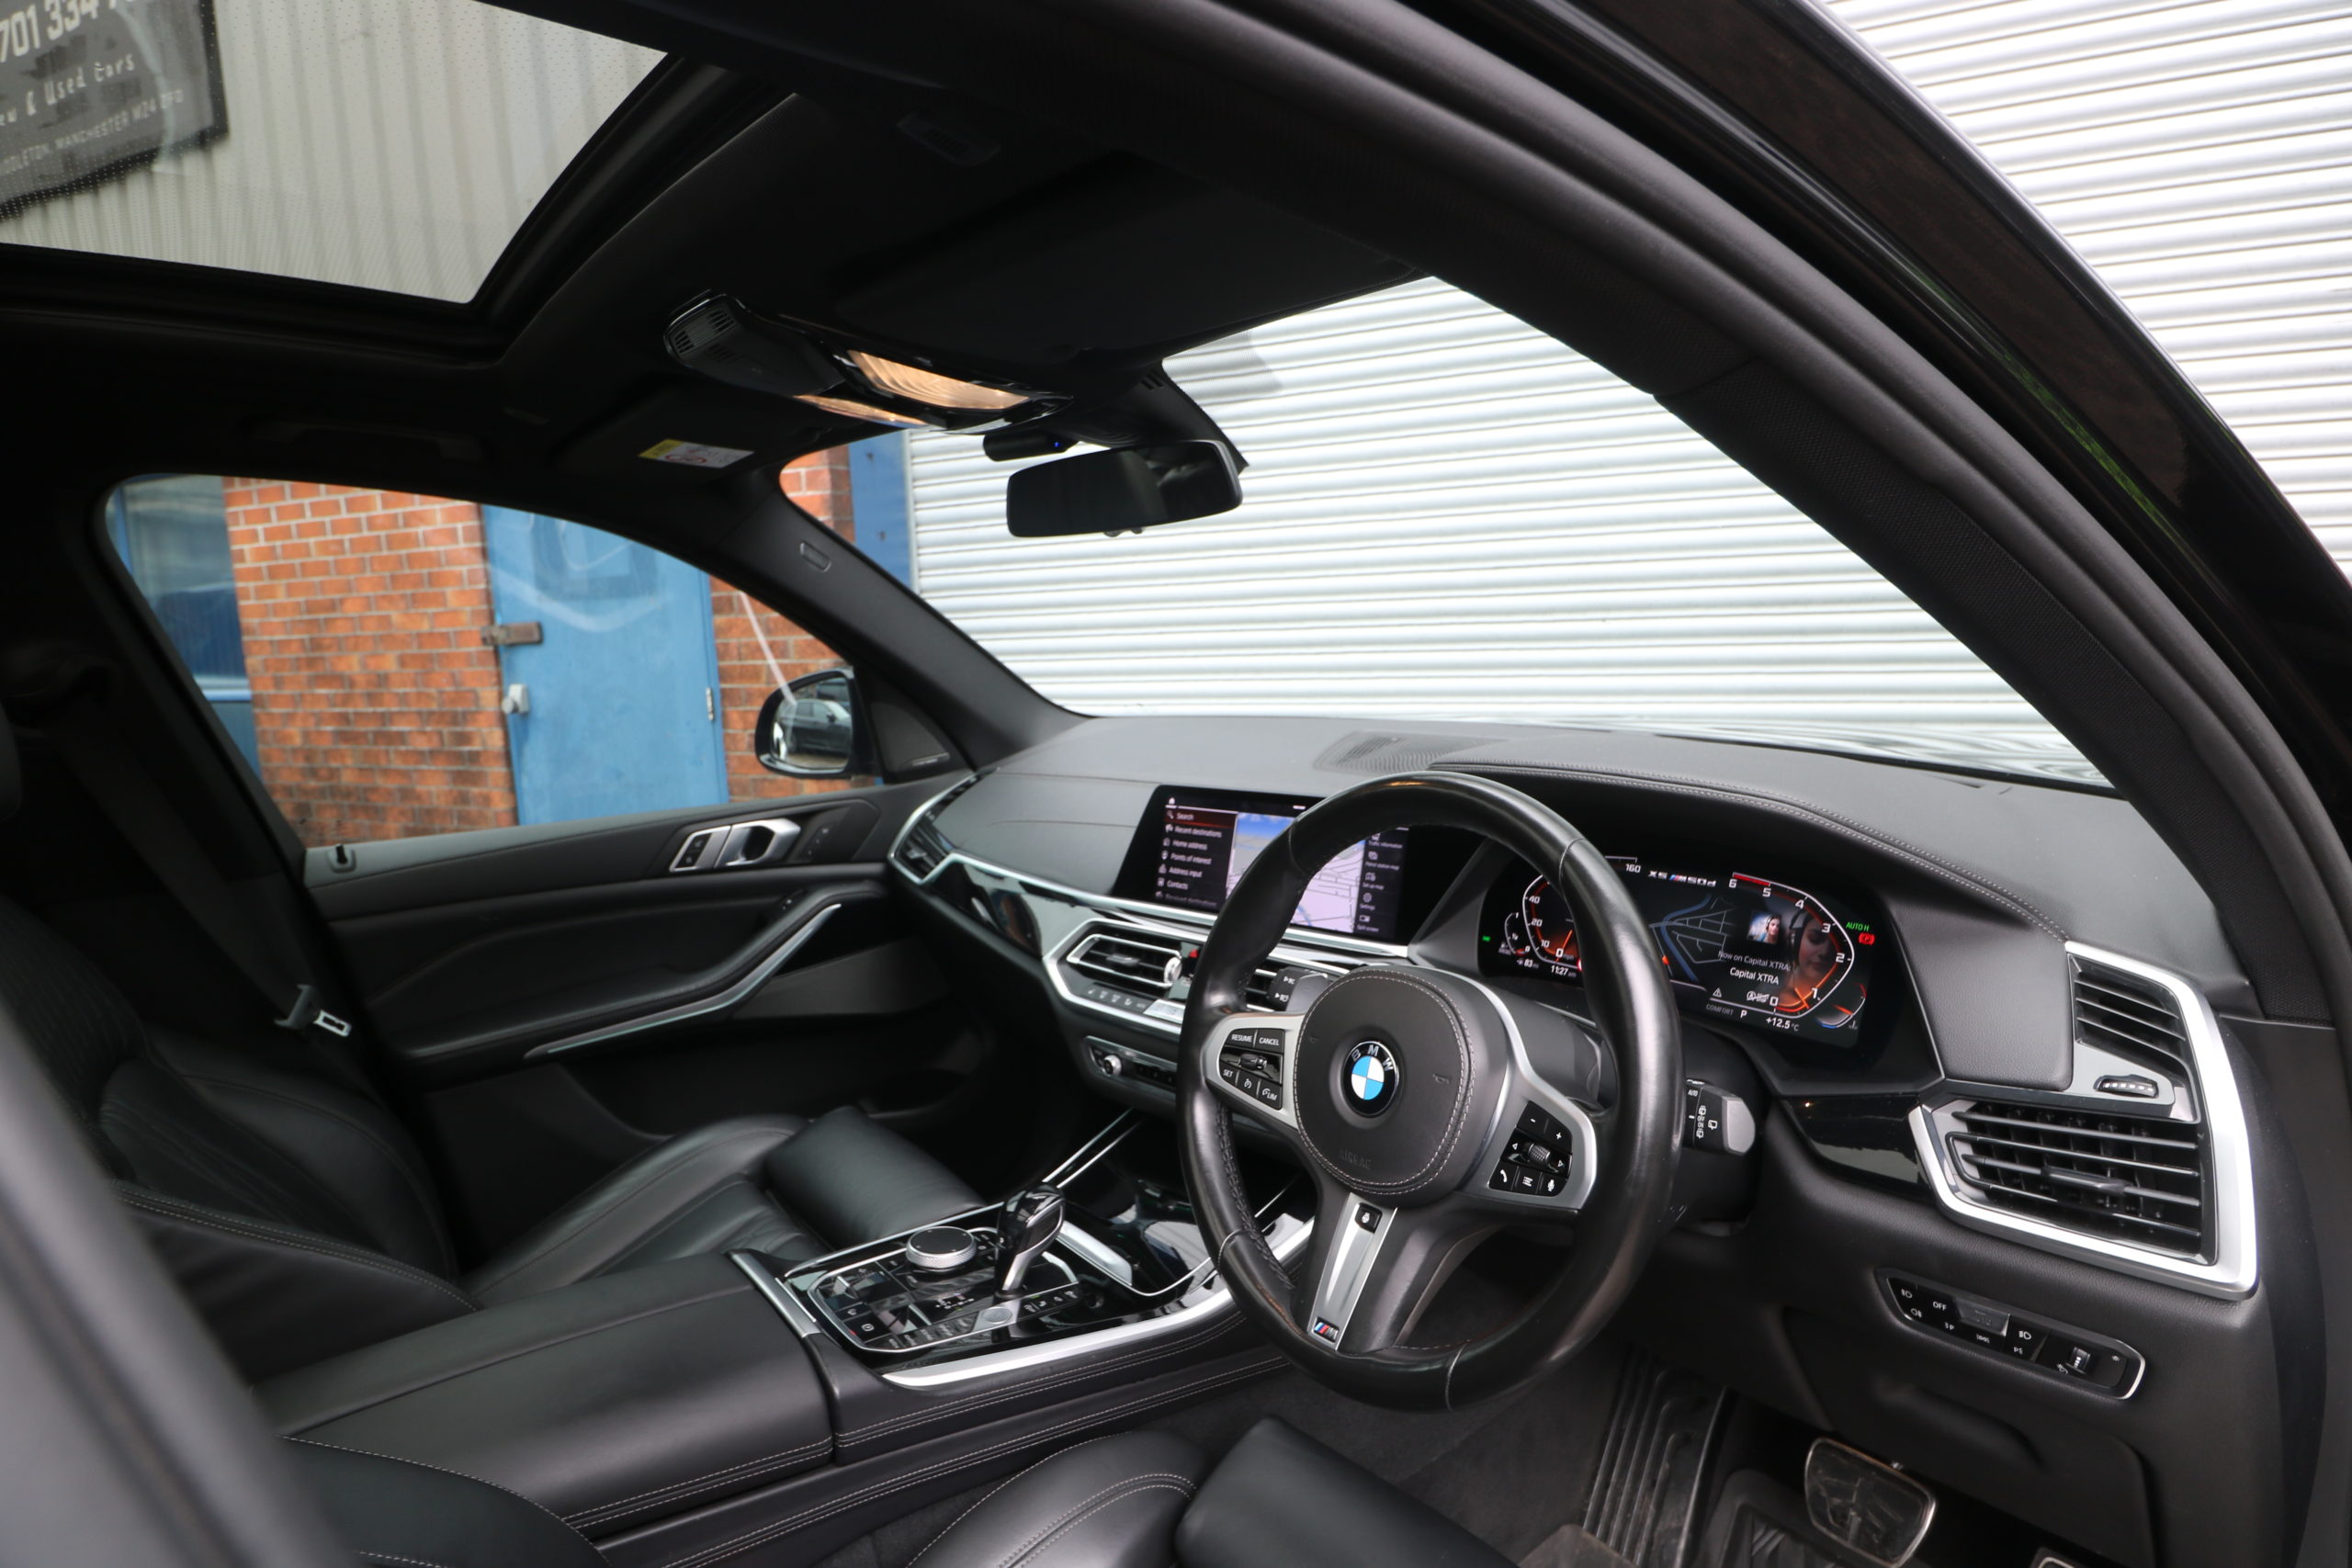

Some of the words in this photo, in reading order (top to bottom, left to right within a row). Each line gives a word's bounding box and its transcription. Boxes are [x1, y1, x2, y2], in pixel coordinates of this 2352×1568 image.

[44, 66, 87, 106] Used
[94, 54, 135, 83] Cars
[55, 109, 130, 150] MANCHESTER
[1177, 812, 1193, 820] Search
[1175, 826, 1192, 834] Recent
[1193, 829, 1222, 838] destinations
[1172, 839, 1188, 847] Home
[1625, 863, 1641, 874] 160
[1648, 870, 1668, 880] X5
[1729, 878, 1737, 888] 6
[1762, 887, 1771, 897] 5
[1529, 896, 1541, 904] 40
[1794, 899, 1804, 909] 4
[1531, 919, 1543, 927] 20
[1822, 923, 1831, 933] 3
[1846, 921, 1863, 931] AUTO
[1541, 940, 1550, 948] 10
[1555, 948, 1564, 958] 0
[1836, 953, 1845, 963] 2
[1524, 959, 1533, 967] 83
[1718, 951, 1732, 960] Now
[1744, 956, 1768, 967] Capital
[1551, 964, 1569, 976] 11:27
[1729, 967, 1757, 980] Capital
[1758, 973, 1780, 986] XTRA
[1812, 987, 1818, 999] 1
[1770, 997, 1779, 1007] 0
[1740, 1010, 1747, 1019] P
[1766, 1017, 1791, 1030] +12.5
[1231, 1033, 1252, 1043] RESUME
[1259, 1037, 1280, 1046] CANCEL
[1351, 1043, 1394, 1073] BMW
[1223, 1068, 1233, 1077] SET
[1932, 1301, 1947, 1311] OFF
